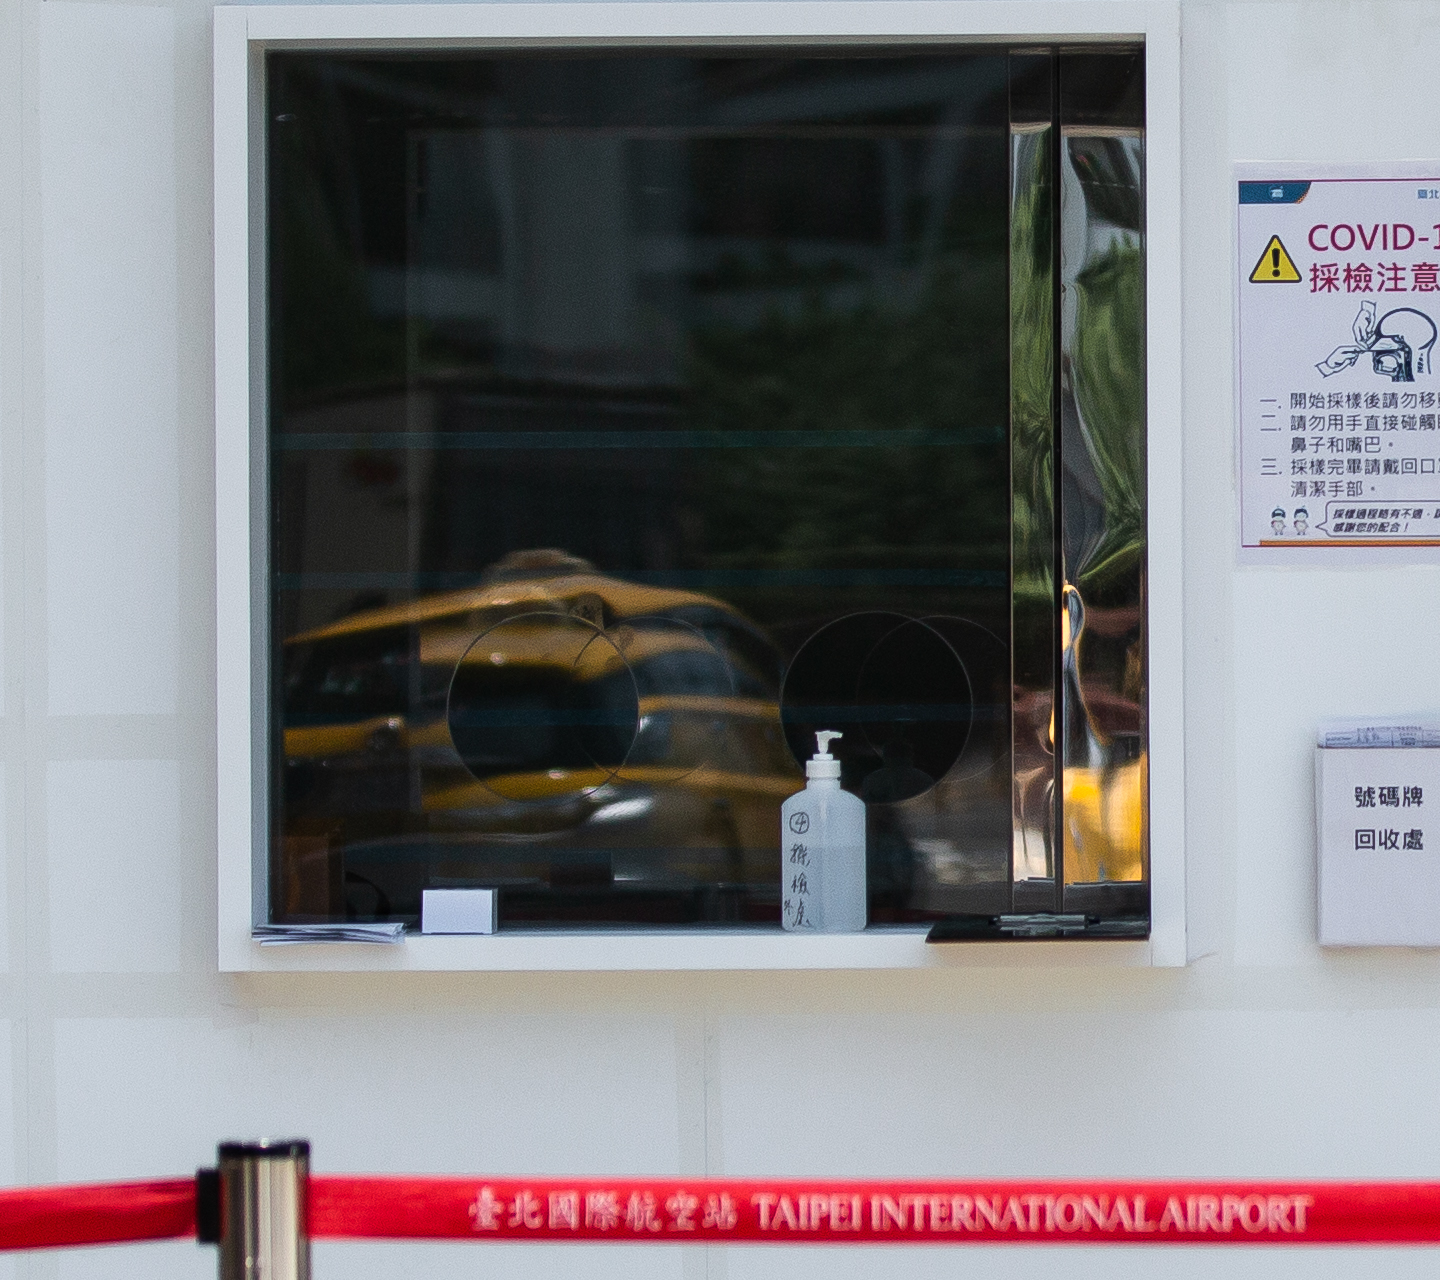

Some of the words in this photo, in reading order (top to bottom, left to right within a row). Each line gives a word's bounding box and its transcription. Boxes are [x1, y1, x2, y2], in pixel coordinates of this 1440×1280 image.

[1355, 786, 1423, 807] 號碼牌
[1355, 829, 1423, 850] 回收處
[468, 1185, 739, 1232] 臺北國際航空站
[750, 1192, 861, 1232] TAIPEI
[870, 1193, 1158, 1233] INTERNATIONAL
[1160, 1193, 1314, 1233] AIRPORT
